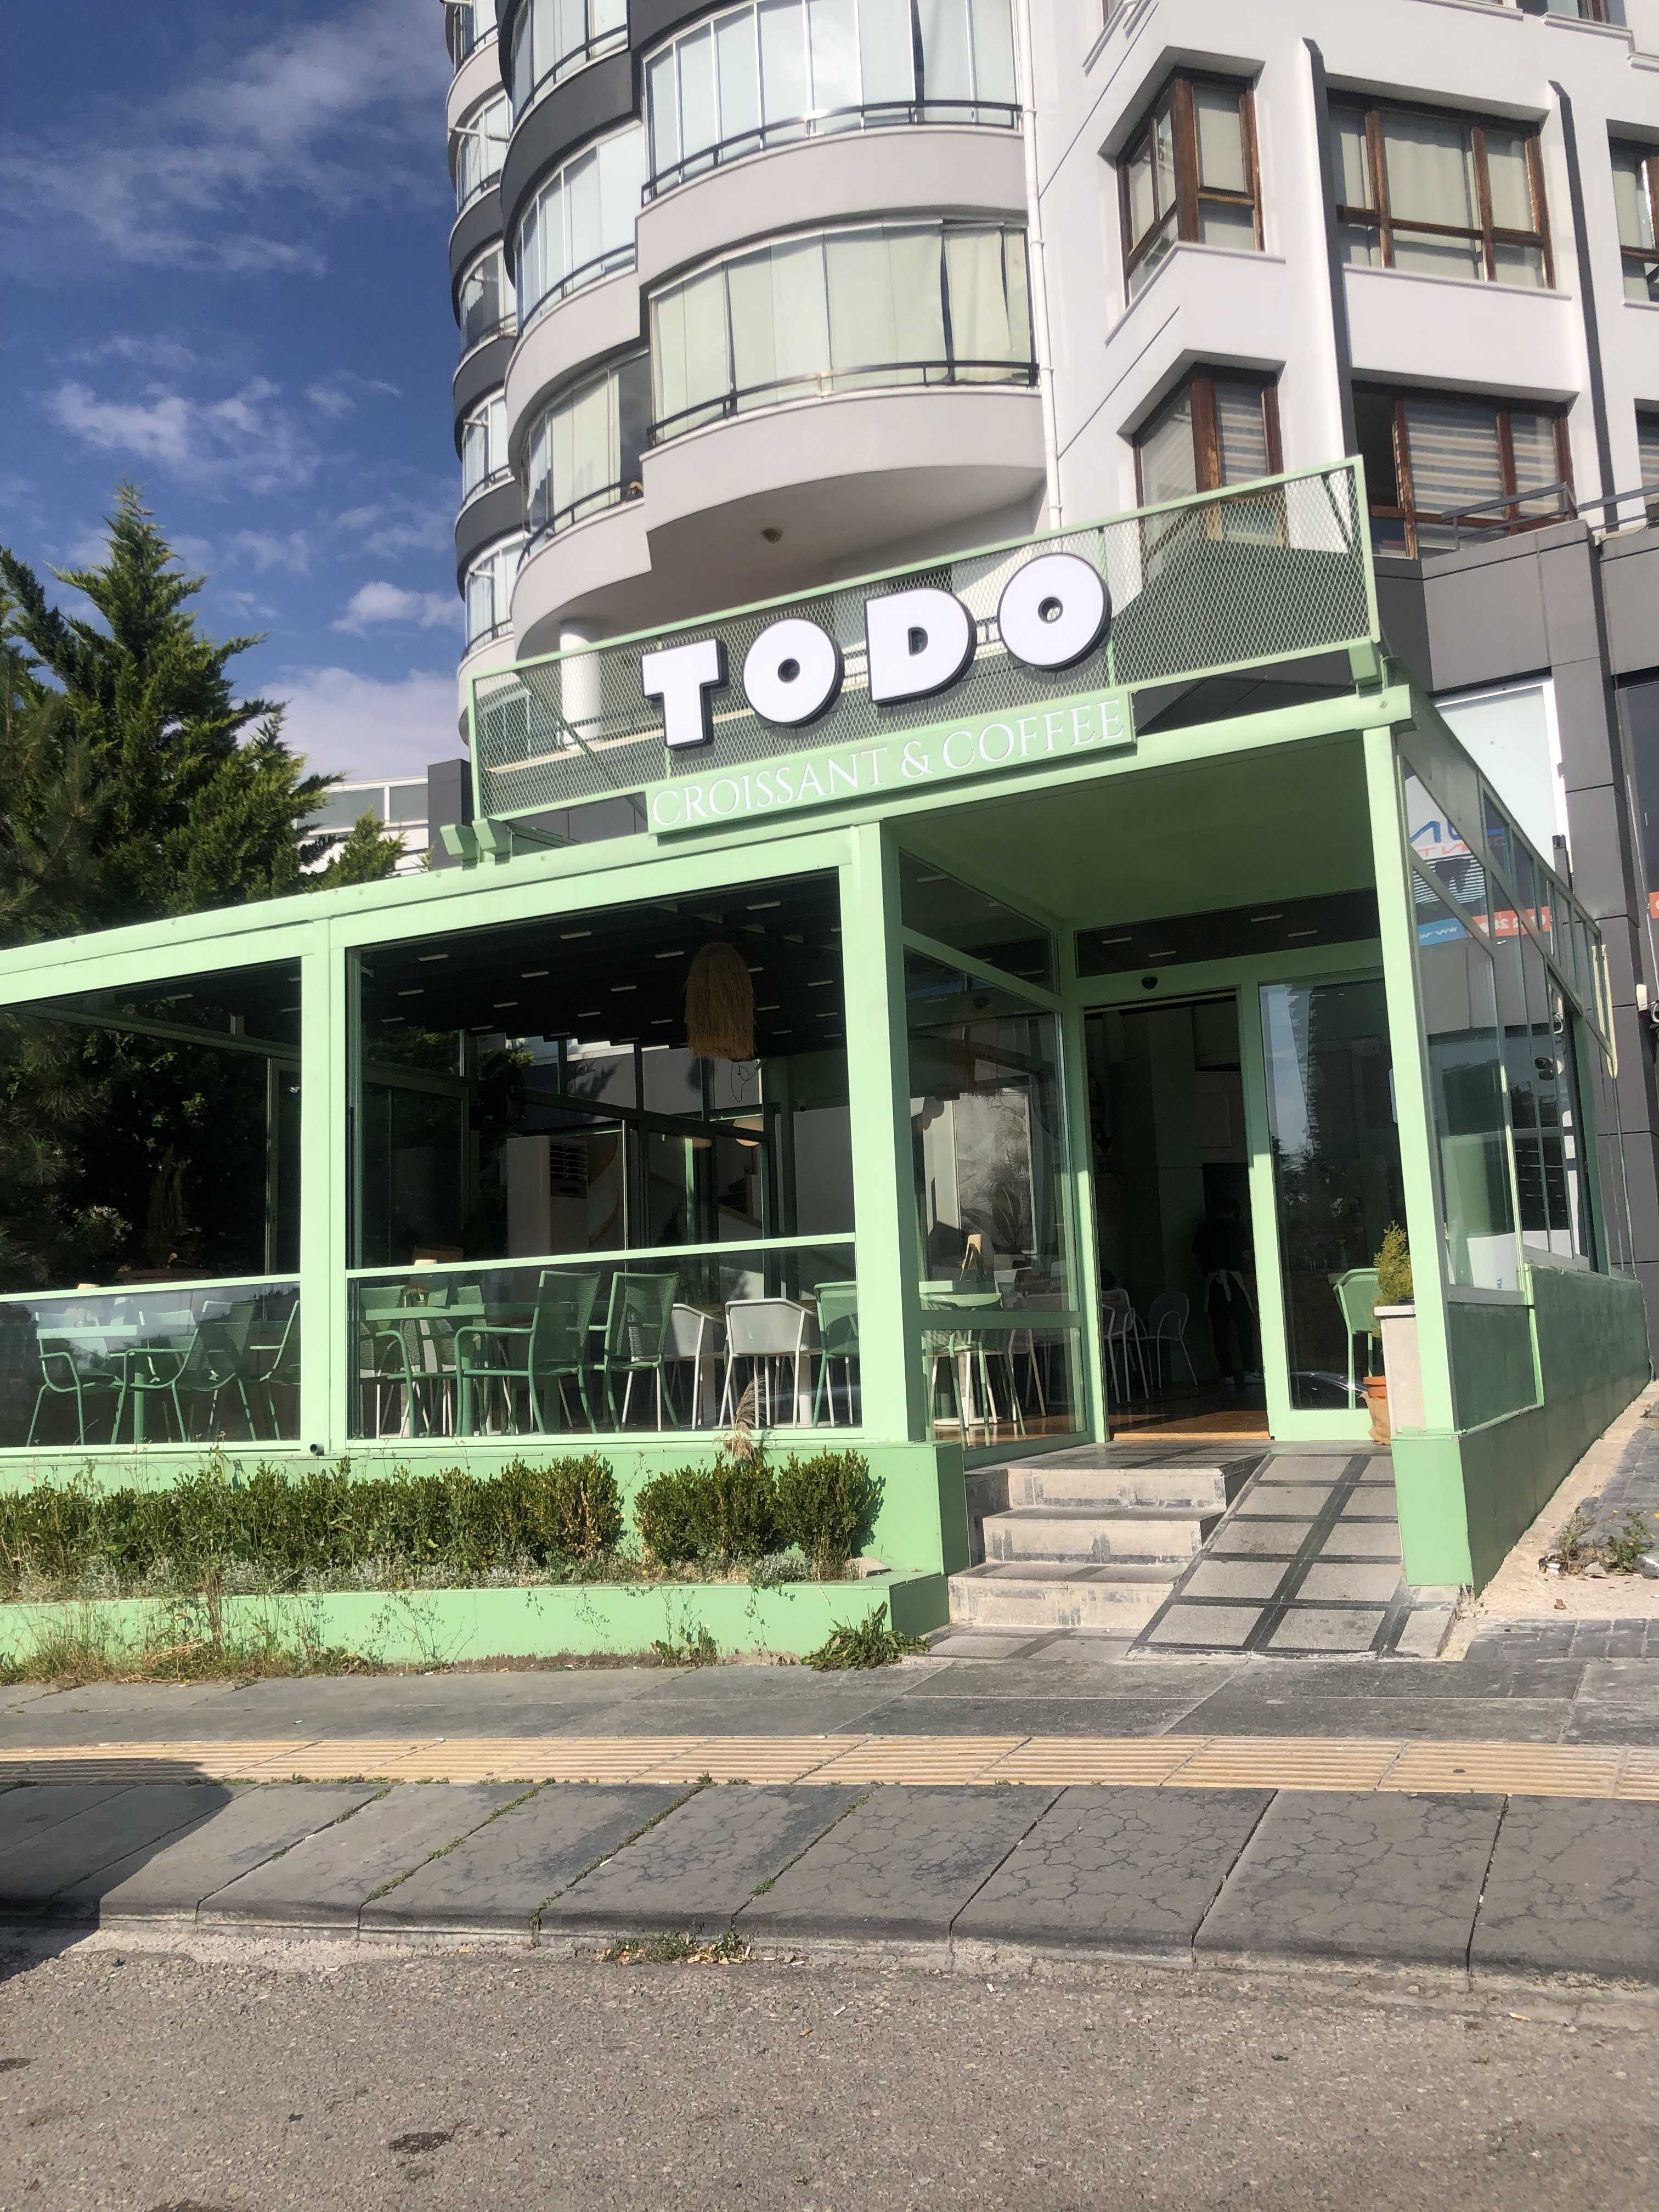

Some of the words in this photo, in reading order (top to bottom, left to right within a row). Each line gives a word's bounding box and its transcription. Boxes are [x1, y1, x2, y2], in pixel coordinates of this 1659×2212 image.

[641, 552, 1111, 749] TODO
[652, 746, 888, 826] CROISSANT
[901, 740, 934, 778] &
[942, 698, 1124, 769] COFFEE
